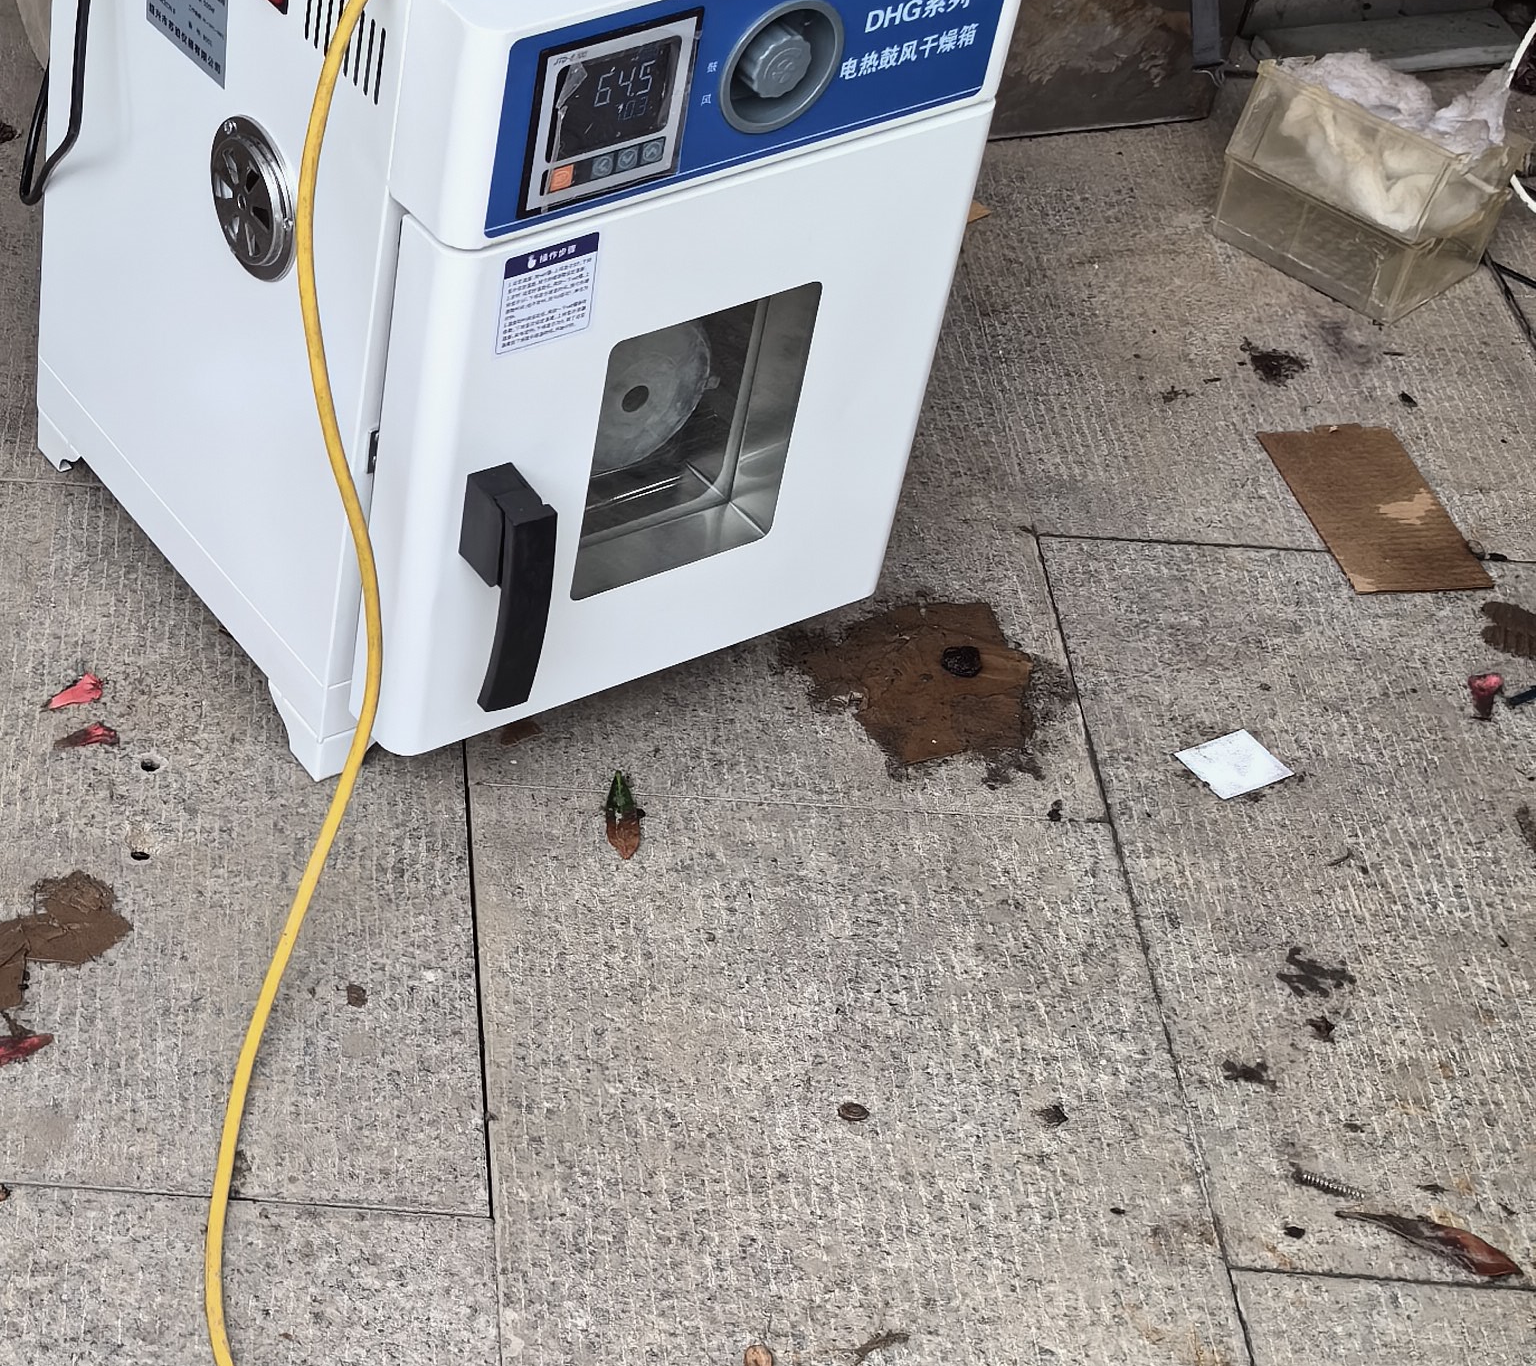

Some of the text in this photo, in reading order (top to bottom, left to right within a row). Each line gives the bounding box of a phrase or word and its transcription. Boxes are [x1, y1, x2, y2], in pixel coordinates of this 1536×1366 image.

[839, 23, 979, 80] 电热鼓风干燥箱
